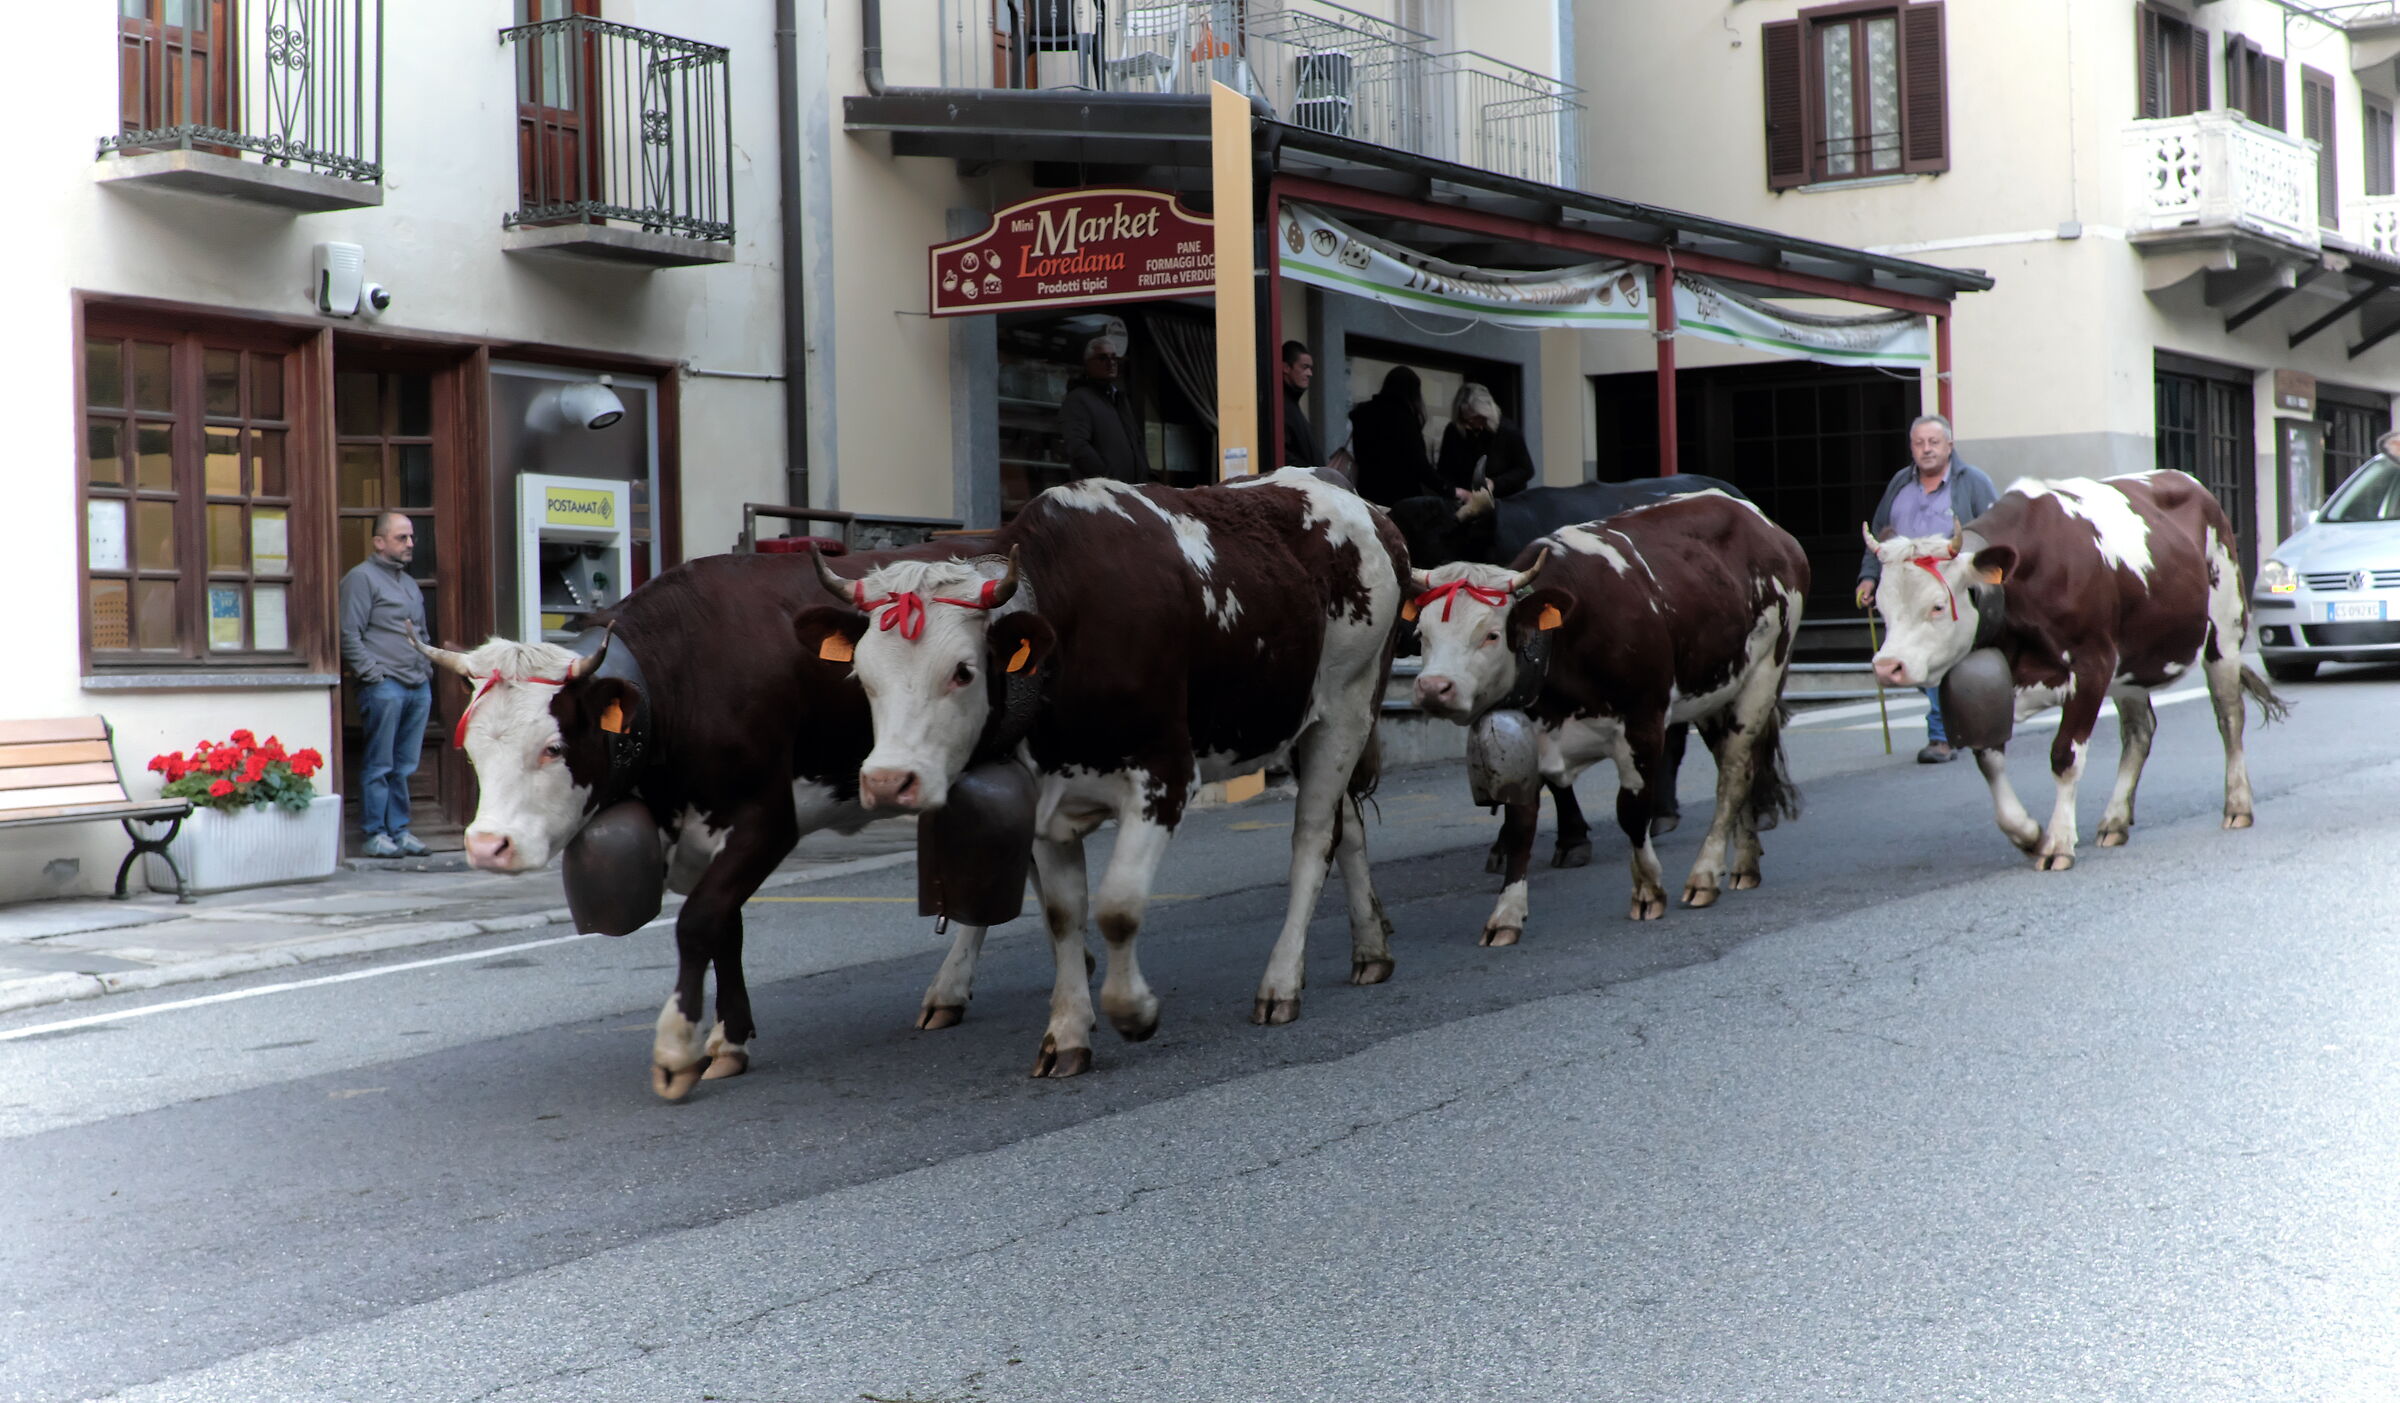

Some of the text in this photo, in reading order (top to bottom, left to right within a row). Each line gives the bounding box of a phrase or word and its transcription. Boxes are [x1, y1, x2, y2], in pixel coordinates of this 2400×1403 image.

[1011, 202, 1161, 257] Mini Market
[1177, 241, 1202, 254] PANE
[1017, 244, 1126, 278] Loredana
[1146, 254, 1215, 271] FORMAGGI LOC
[1038, 277, 1108, 294] Prodotti tipici
[1138, 268, 1217, 287] FRUTTA e VERDUR
[547, 498, 598, 514] POSTAMAT
